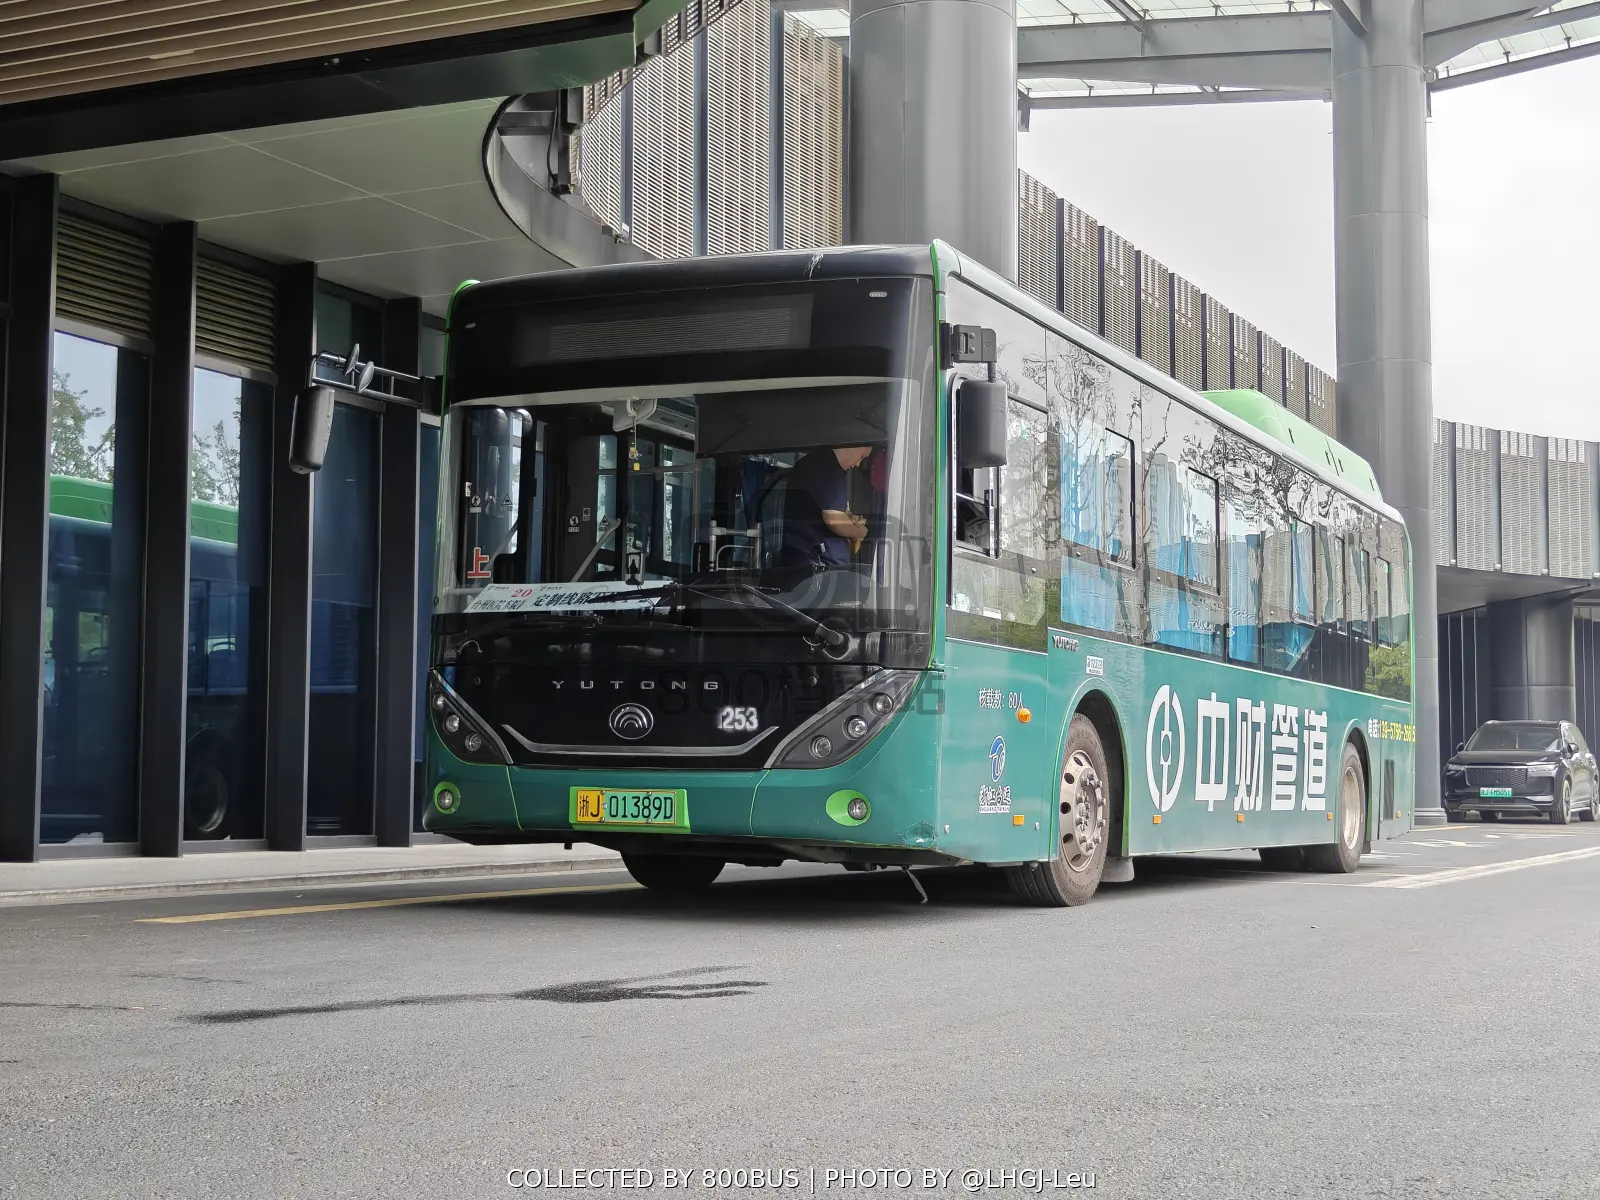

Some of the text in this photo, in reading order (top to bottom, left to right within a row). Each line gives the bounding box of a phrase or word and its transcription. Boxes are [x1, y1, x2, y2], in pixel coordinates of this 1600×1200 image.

[1052, 635, 1080, 652] YUTONG
[551, 679, 719, 690] YUTONG
[1195, 692, 1328, 812] 中财管道
